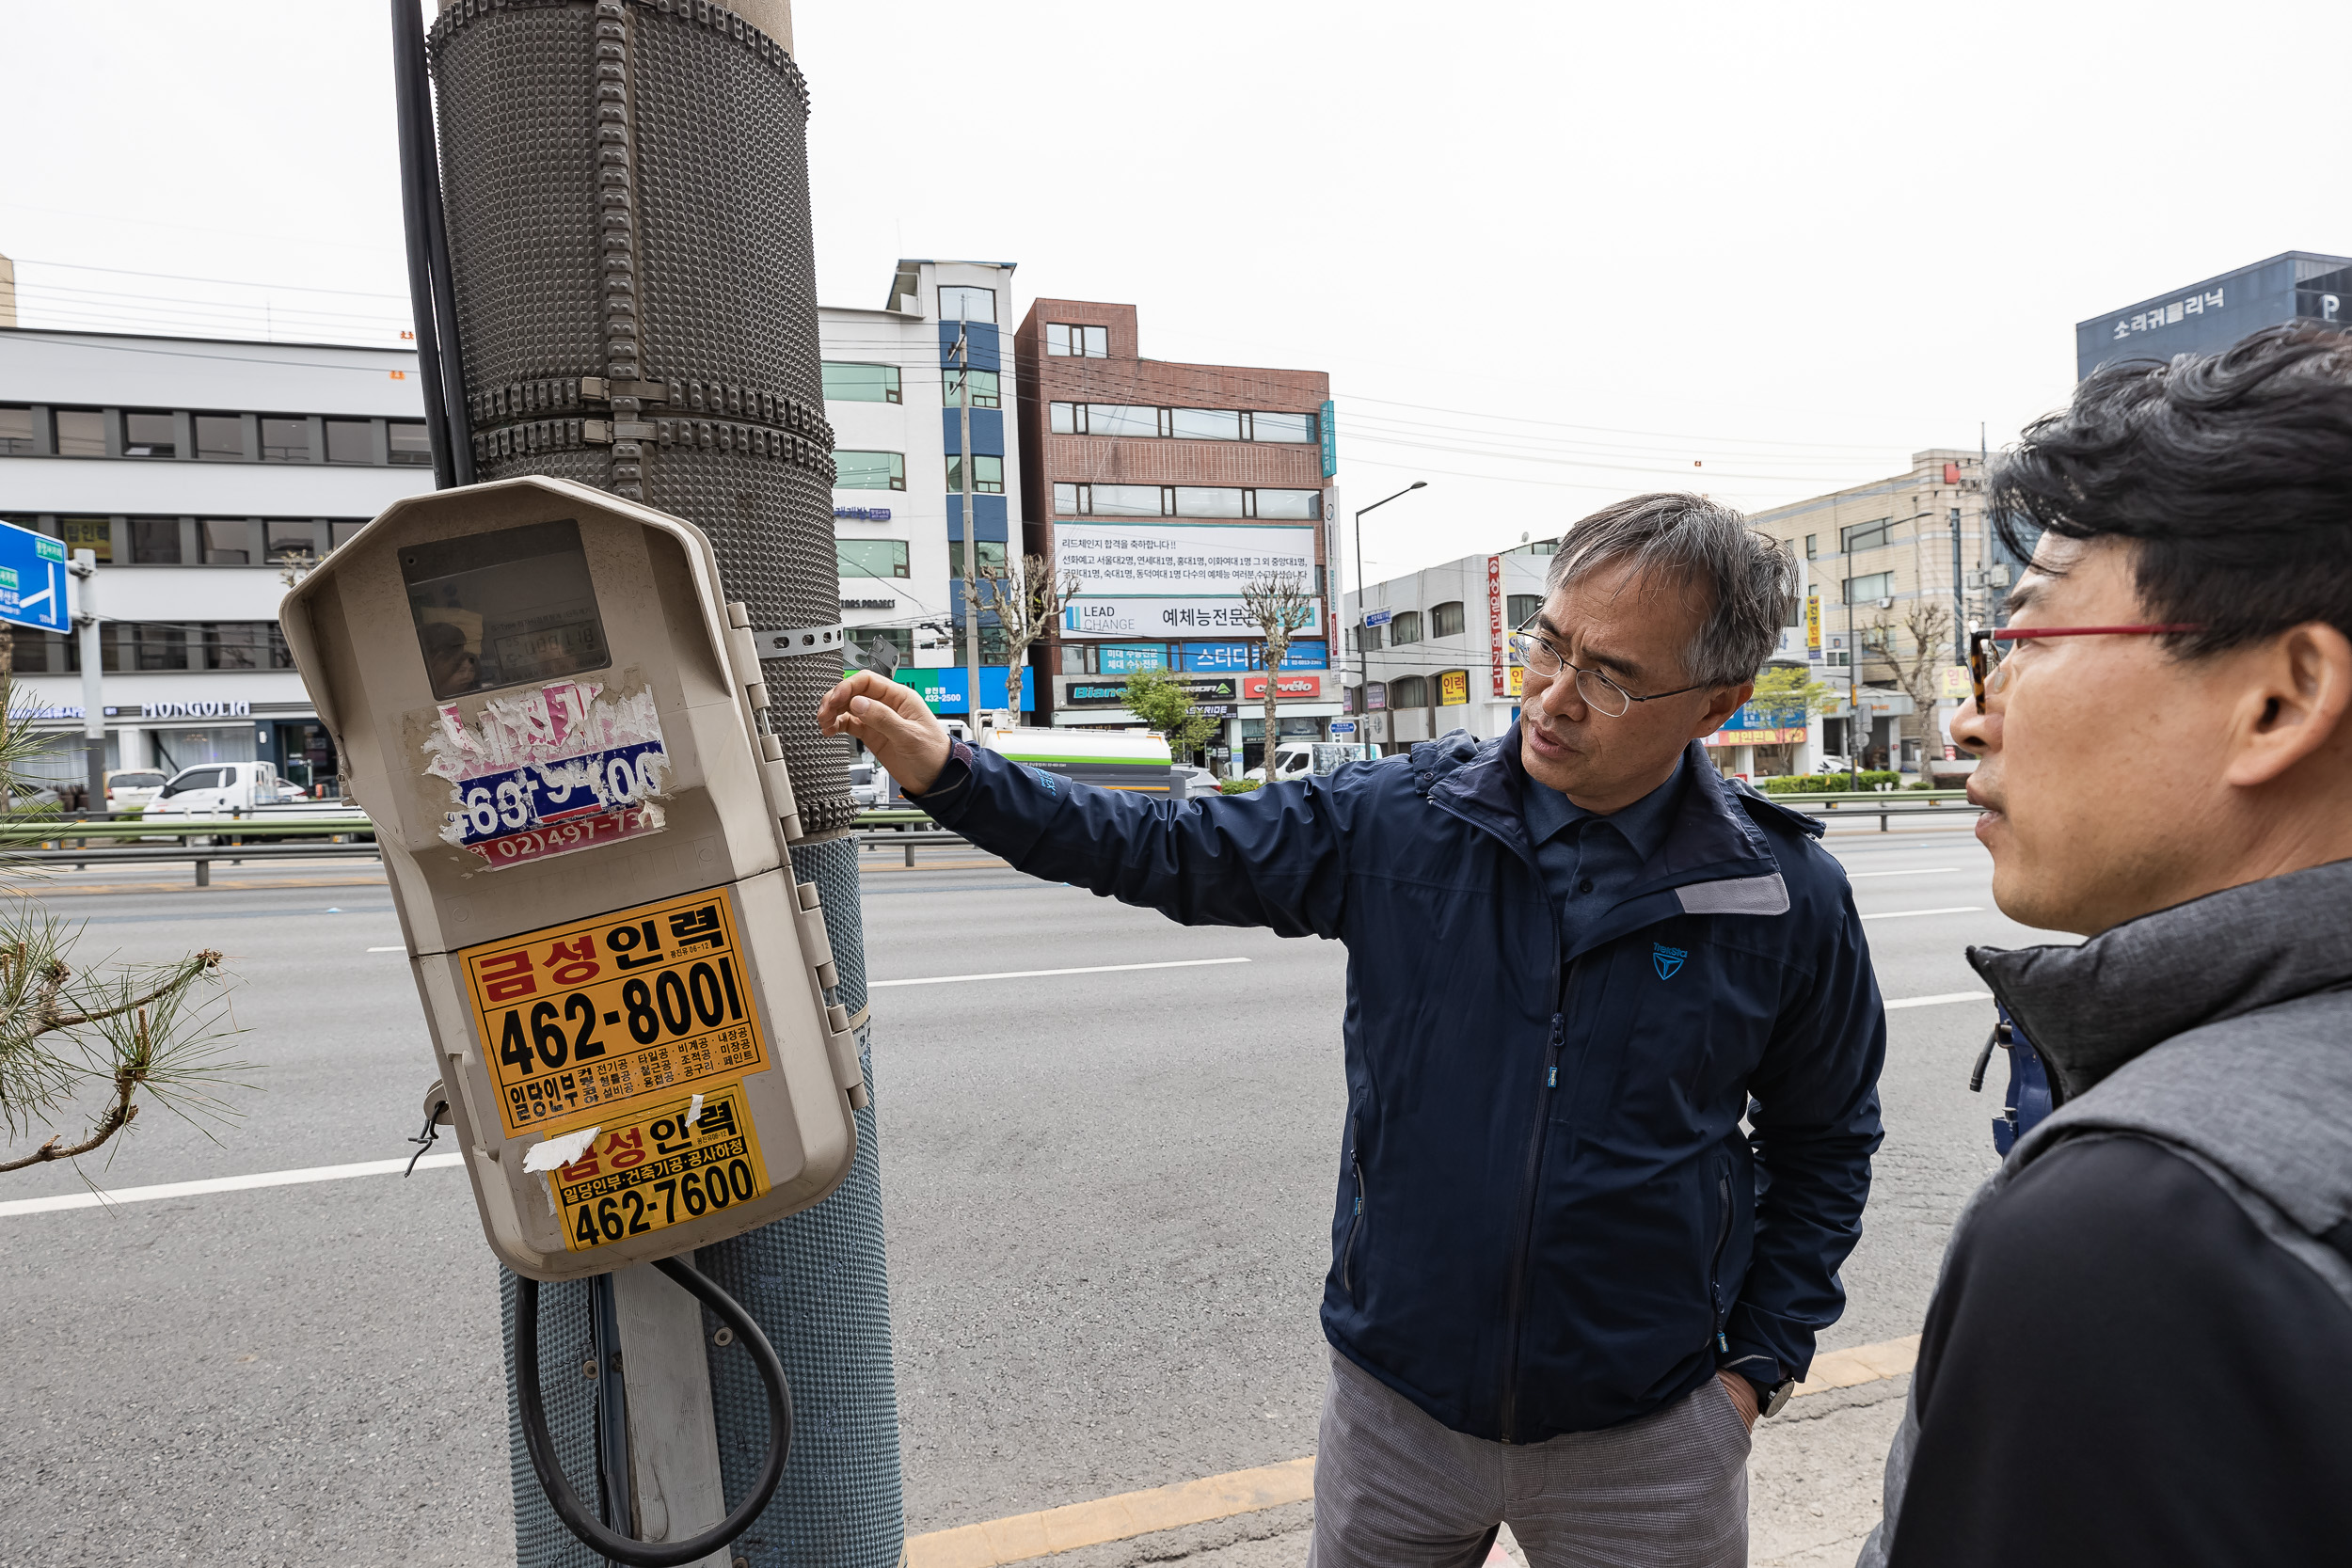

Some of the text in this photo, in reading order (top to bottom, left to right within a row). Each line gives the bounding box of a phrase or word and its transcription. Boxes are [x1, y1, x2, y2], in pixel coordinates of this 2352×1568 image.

[1062, 539, 1103, 549] 리드체인지
[1104, 540, 1128, 549] 합격을
[1131, 540, 1169, 549] 축하합니다
[1062, 555, 1095, 565] 선화예고
[1208, 557, 1238, 566] 이화여대
[1240, 557, 1251, 566] 1명
[1183, 570, 1206, 579] 다수의
[1207, 570, 1231, 579] 예체능
[1232, 570, 1255, 579] 여러분
[1084, 607, 1115, 617] LEAD
[1083, 618, 1136, 630] CHANGE
[1443, 674, 1465, 695] 인력
[141, 700, 251, 720] MONGOLIA
[1203, 705, 1228, 714] RIDE
[1653, 942, 1689, 958] TrekSta
[500, 956, 744, 1076] 462-8001
[596, 1026, 748, 1075] 전기공 타일공 비계공 내장공
[680, 1049, 711, 1066] 조적공
[721, 1037, 751, 1054] 미장공
[603, 1082, 634, 1100] 설비공
[683, 1059, 714, 1078] 공구리
[723, 1050, 754, 1066] 페인트
[575, 1158, 754, 1246] 462-7600
